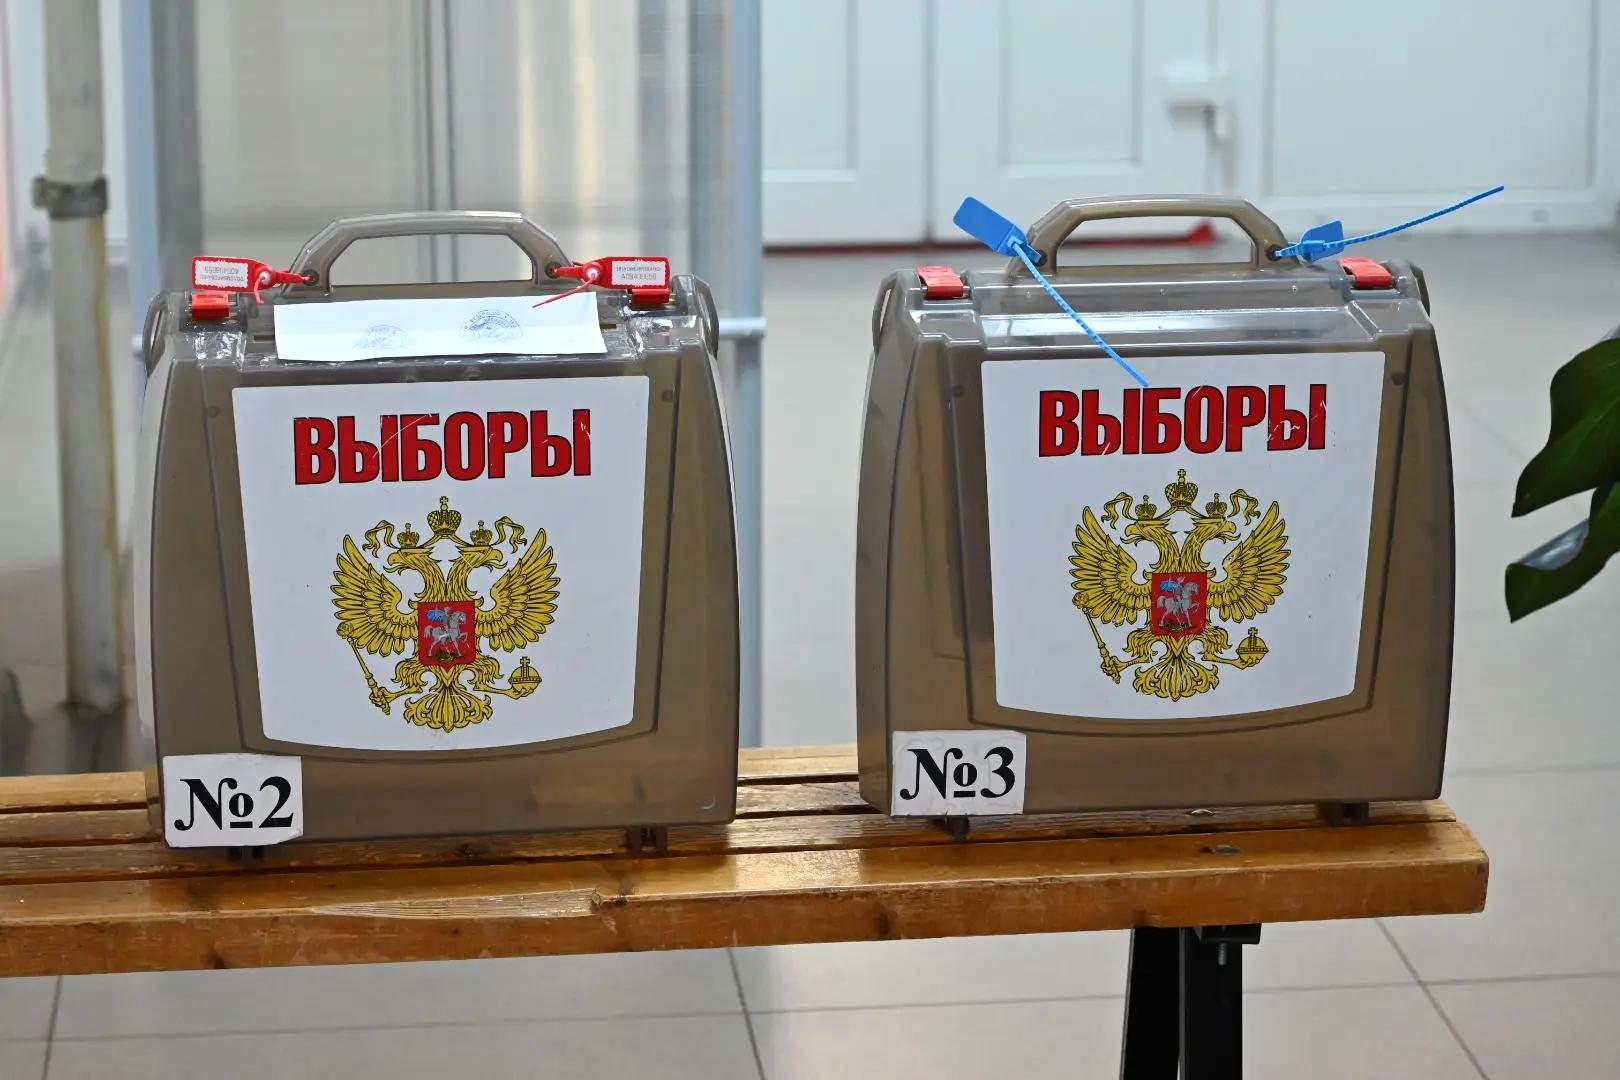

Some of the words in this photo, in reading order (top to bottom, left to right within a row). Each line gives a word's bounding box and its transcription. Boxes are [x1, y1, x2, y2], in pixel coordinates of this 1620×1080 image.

[293, 408, 592, 486] ВЫБОРЫ
[1038, 383, 1328, 458] ВЫБОРЫ
[173, 775, 294, 832] №2
[899, 746, 1016, 801] №3
